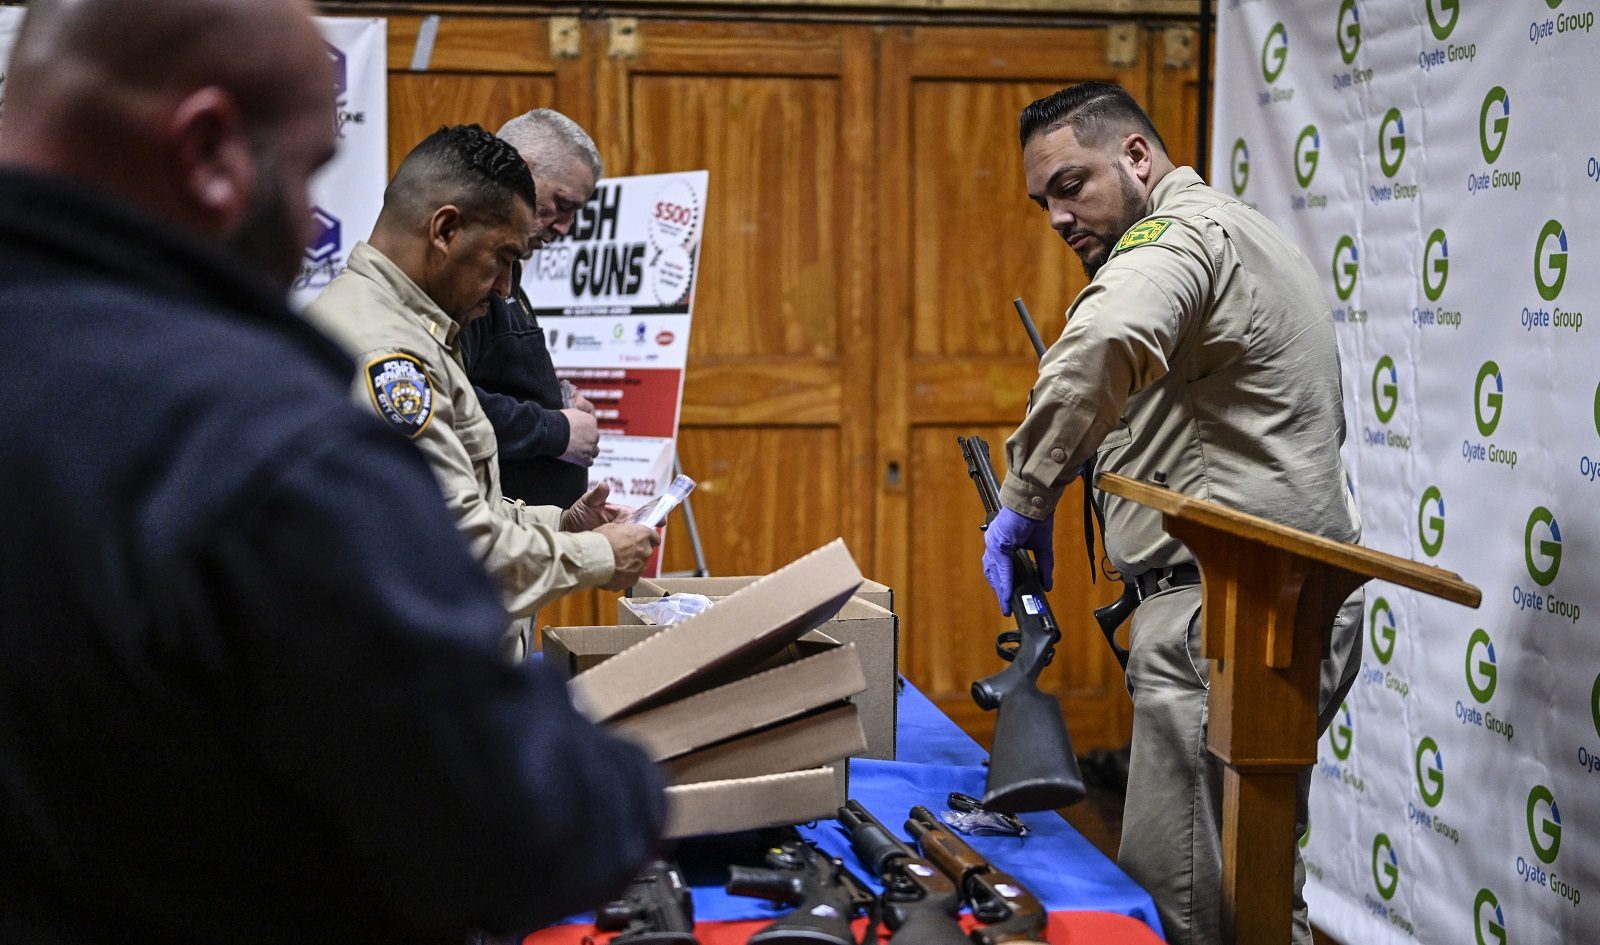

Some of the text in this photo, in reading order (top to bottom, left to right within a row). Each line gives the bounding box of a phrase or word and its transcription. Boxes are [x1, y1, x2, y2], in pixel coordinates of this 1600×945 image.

[1529, 11, 1594, 45] Oyate Group
[1419, 44, 1476, 71] Oyate Group
[1393, 183, 1418, 202] Group
[1468, 169, 1521, 196] Oyate Group
[655, 201, 692, 226] $500
[570, 243, 646, 298] GUNS
[1412, 307, 1461, 330] Oyate Group
[1521, 307, 1583, 333] Oyate Group
[1387, 430, 1411, 452] Group
[1463, 440, 1517, 469] Oyate Group
[630, 478, 656, 496] 2022
[1512, 585, 1580, 623] Oyate Group
[1385, 671, 1408, 698] Group
[1456, 700, 1514, 742] Oyate Group
[1433, 815, 1460, 846] Group
[1516, 856, 1580, 908] Oyate Group
